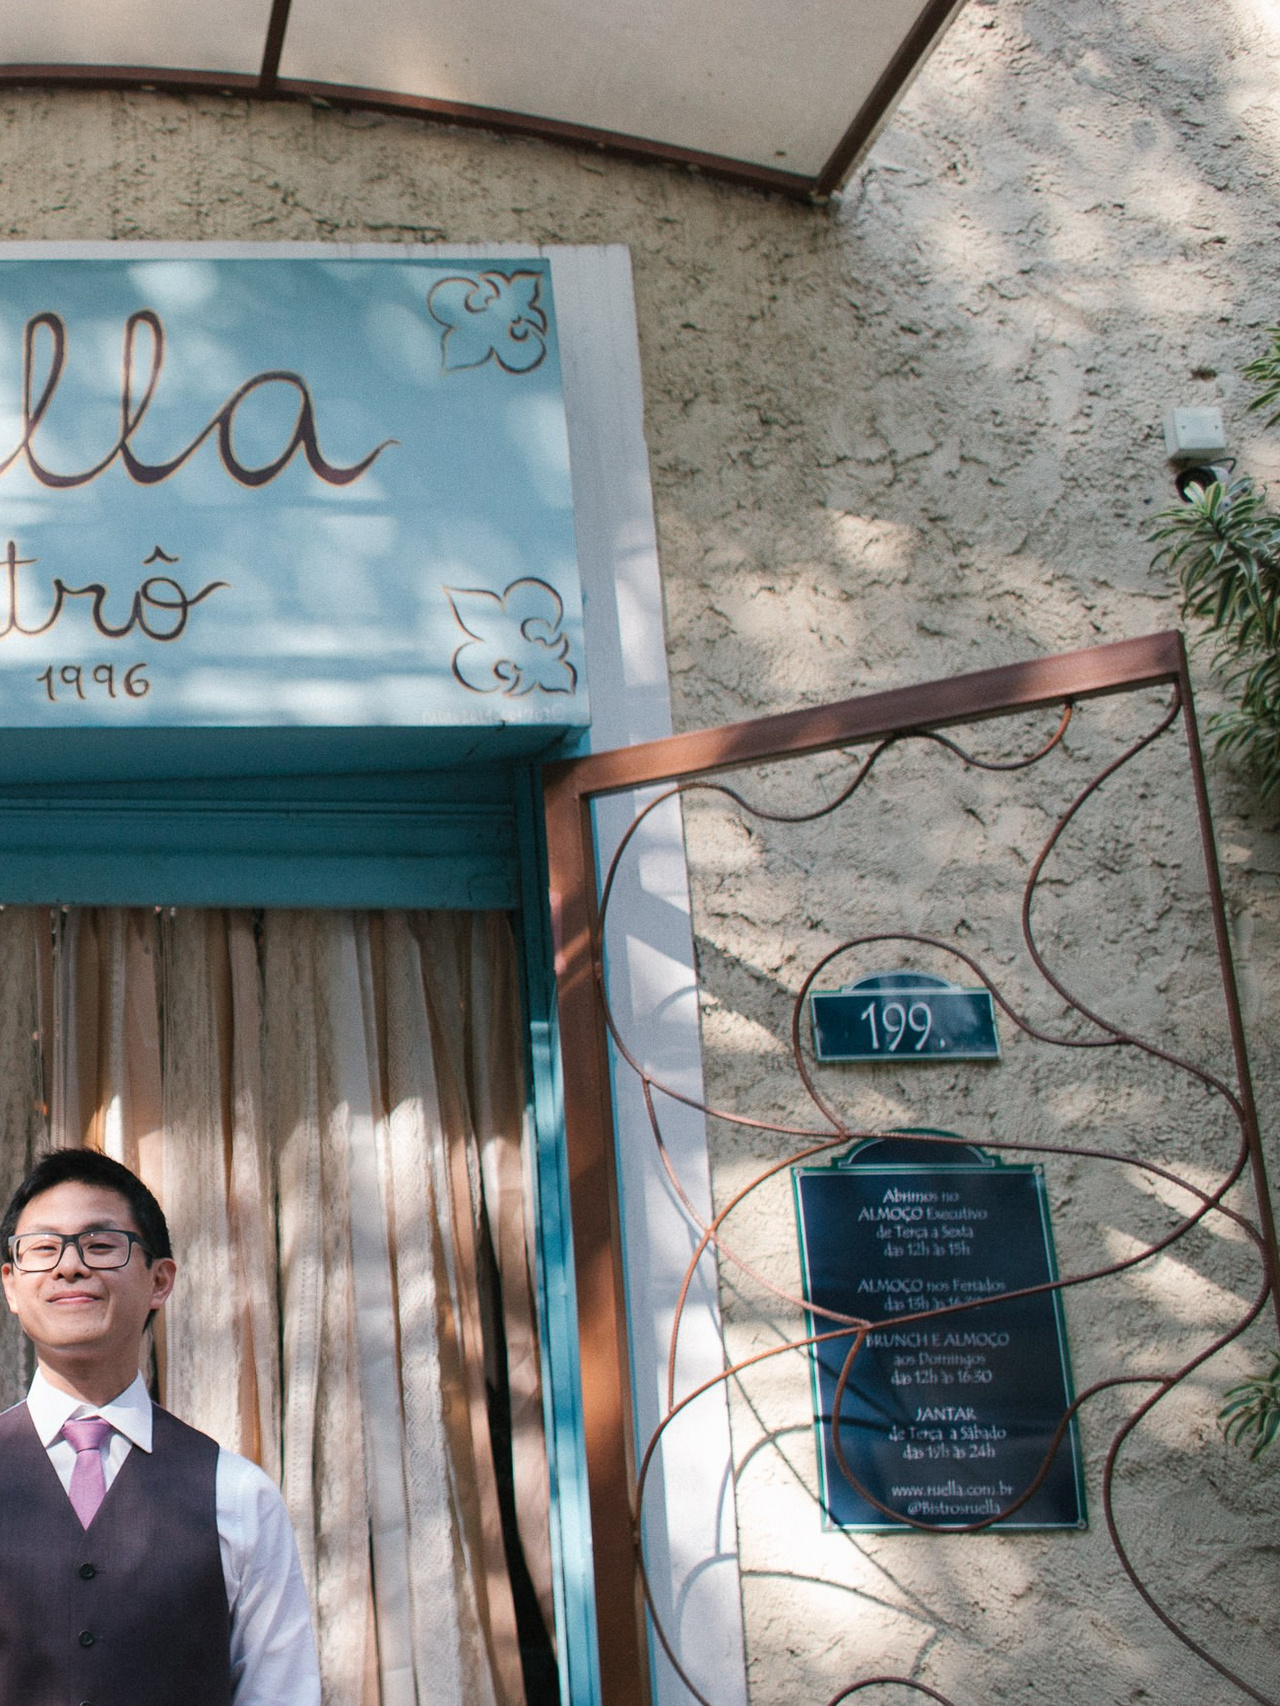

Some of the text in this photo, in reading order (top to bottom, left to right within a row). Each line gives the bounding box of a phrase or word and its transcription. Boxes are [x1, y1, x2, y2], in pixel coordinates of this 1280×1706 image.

[37, 662, 151, 701] 1996
[883, 1187, 960, 1203] Abrimos no
[858, 1206, 988, 1223] ALMOÇO Executivo
[876, 1224, 893, 1239] de
[894, 1225, 928, 1239] Terça
[941, 1224, 974, 1238] Sexta
[884, 1242, 904, 1257] das
[908, 1241, 929, 1256] 12h
[857, 1277, 1005, 1293] ALMOÇO nos Feriados
[884, 1295, 905, 1311] das
[866, 1331, 1010, 1349] BRUNCH E ALMOÇO
[894, 1352, 986, 1369] aos Domingos
[891, 1368, 912, 1385] das
[915, 1368, 938, 1384] 12h
[916, 1405, 977, 1421] JANTAR
[889, 1424, 905, 1441] de
[909, 1426, 943, 1442] Terça
[960, 1424, 1007, 1441] Sábado
[903, 1443, 924, 1460] das
[969, 1442, 995, 1458] 24h
[891, 1479, 1013, 1497] www.ruella.com.br
